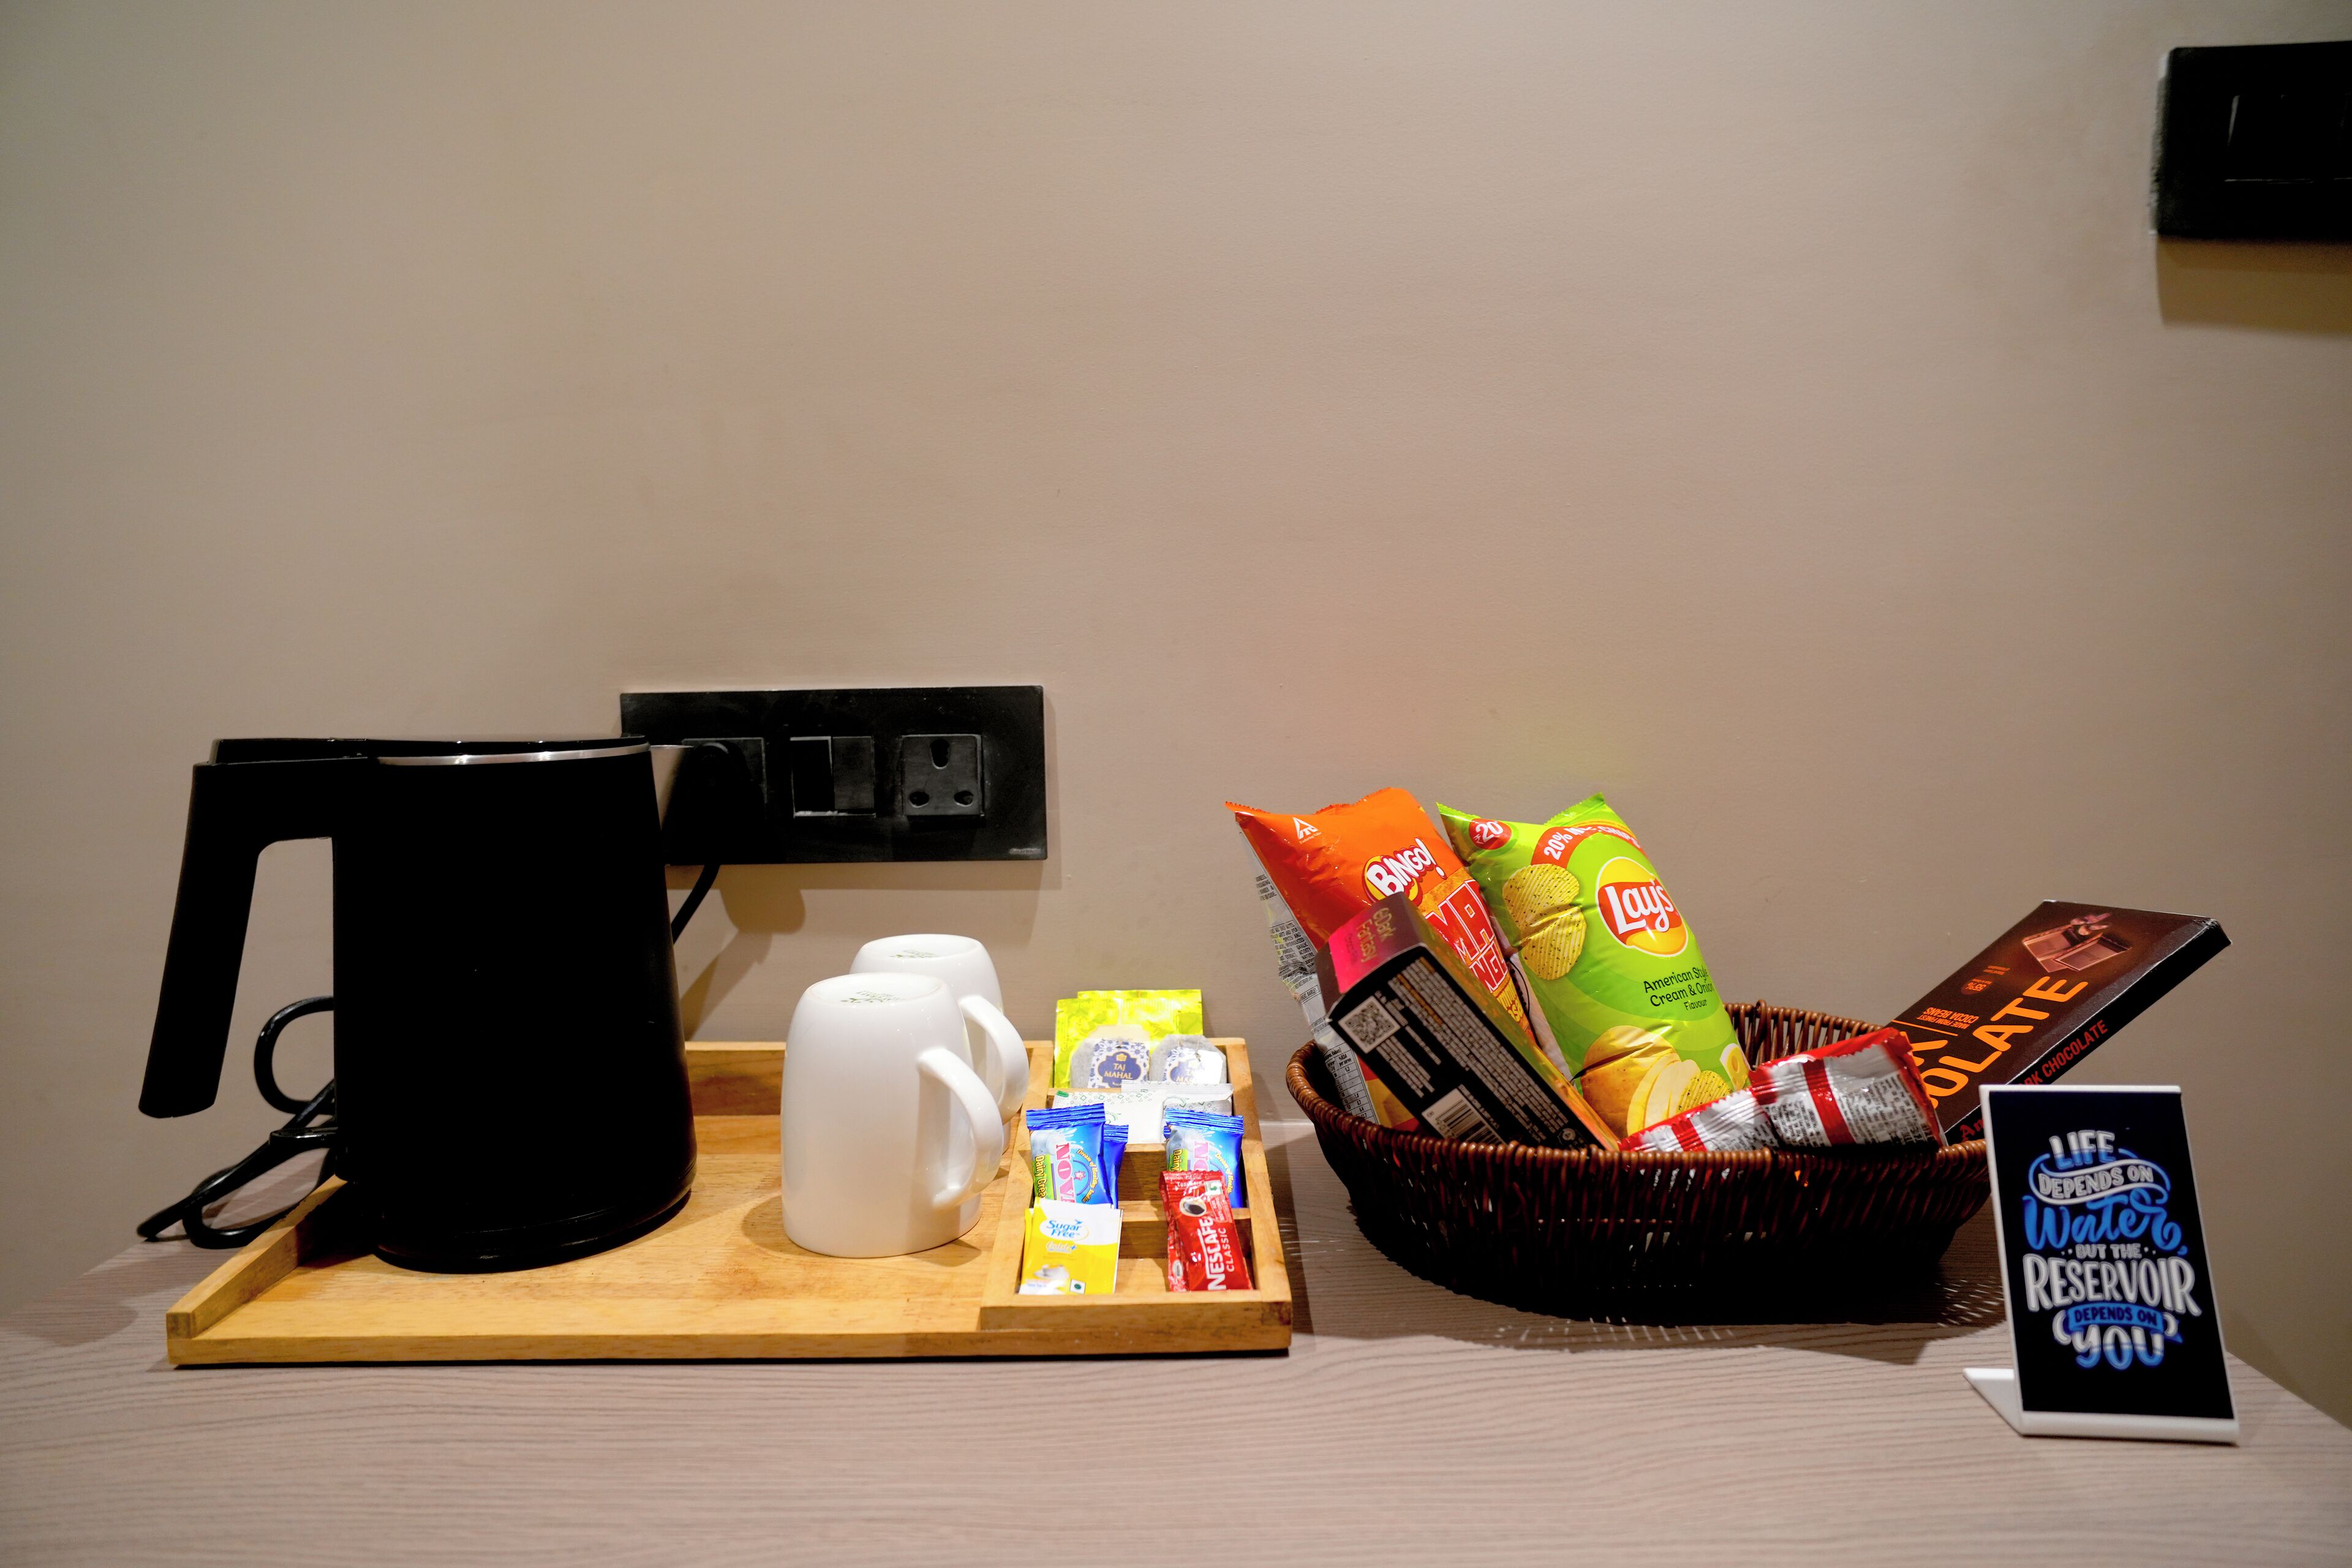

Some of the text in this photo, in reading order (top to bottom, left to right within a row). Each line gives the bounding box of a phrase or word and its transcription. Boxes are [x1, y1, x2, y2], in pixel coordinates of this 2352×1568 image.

[1544, 831, 1574, 861] 20%
[1366, 837, 1446, 895] BINGO!
[1604, 879, 1676, 935] Lay's
[1643, 971, 1694, 993] American
[1650, 989, 1689, 1007] Cream
[1687, 984, 1697, 997] &
[1683, 999, 1708, 1011] Flavour
[1916, 1014, 1939, 1023] FINEST
[1923, 1007, 1980, 1024] COCOA BEANS
[1935, 1017, 1953, 1027] FROM
[1922, 975, 2089, 1109] OLATE
[2041, 1019, 2109, 1078] CHOCOLATE
[1104, 1071, 1133, 1080] MAHAL
[1112, 1063, 1126, 1072] TAJ
[1170, 1148, 1183, 1171] Dairy
[2049, 1130, 2116, 1170] LIFE
[1035, 1154, 1047, 1199] Dairy Crea
[2038, 1164, 2154, 1200] DEPENDS ON
[1047, 1219, 1083, 1231] Sugar
[1050, 1228, 1076, 1238] Free
[1218, 1227, 1235, 1273] CLASSIC
[2075, 1243, 2143, 1260] BUT THE
[2023, 1253, 2203, 1317] RESERVOIR
[2074, 1303, 2159, 1327] DEPENDS ON
[2071, 1324, 2165, 1371] YOU
